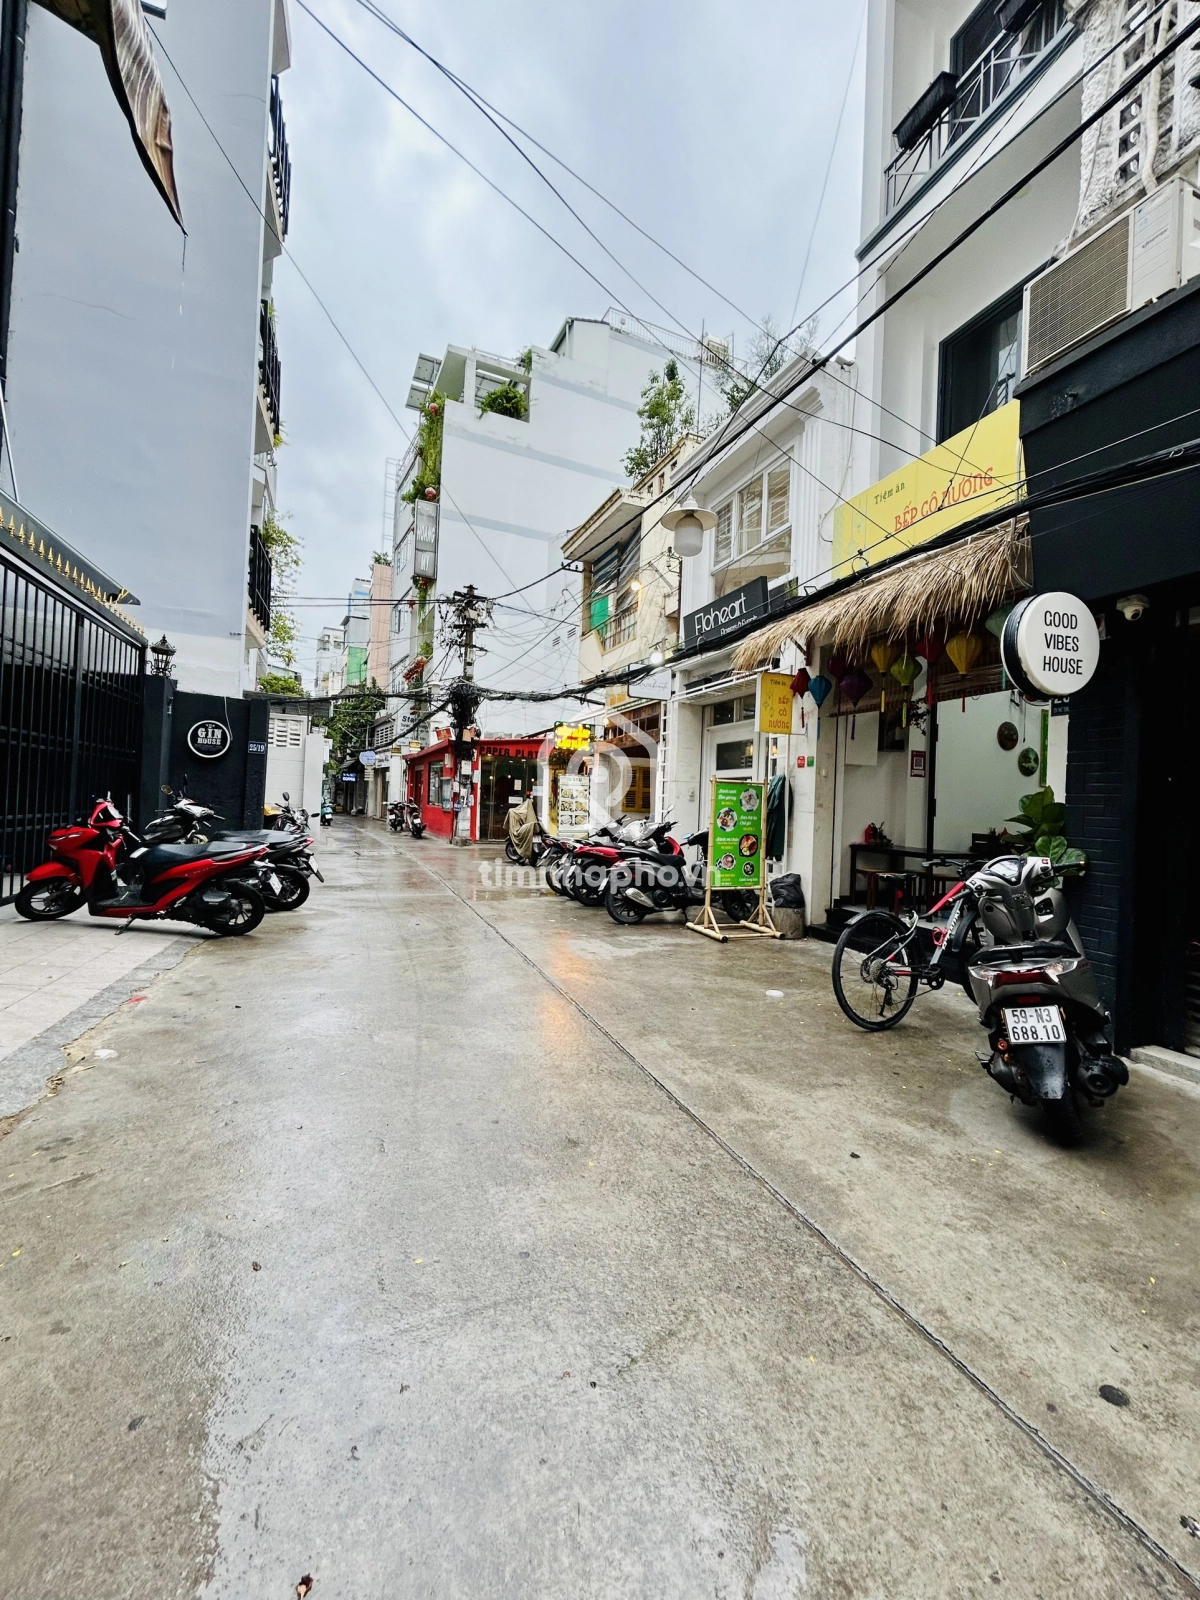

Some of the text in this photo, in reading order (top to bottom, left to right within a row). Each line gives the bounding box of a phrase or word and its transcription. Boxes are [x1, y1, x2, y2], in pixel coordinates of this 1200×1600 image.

[874, 488, 893, 505] Tiệm
[894, 501, 918, 532] BẾP
[920, 490, 938, 516] CÔ
[694, 592, 747, 636] Floheart
[1044, 610, 1078, 630] GOOD
[1044, 633, 1079, 652] VIBES
[1043, 655, 1083, 675] HOUSE
[778, 694, 790, 705] BẾP
[778, 707, 787, 717] CÔ
[197, 727, 222, 739] GIN
[197, 737, 221, 745] HOUSE
[249, 743, 265, 752] 25/19
[480, 746, 545, 759] PAPER PLATE
[1011, 1007, 1053, 1024] 59-N3
[1011, 1025, 1061, 1042] 688.10
